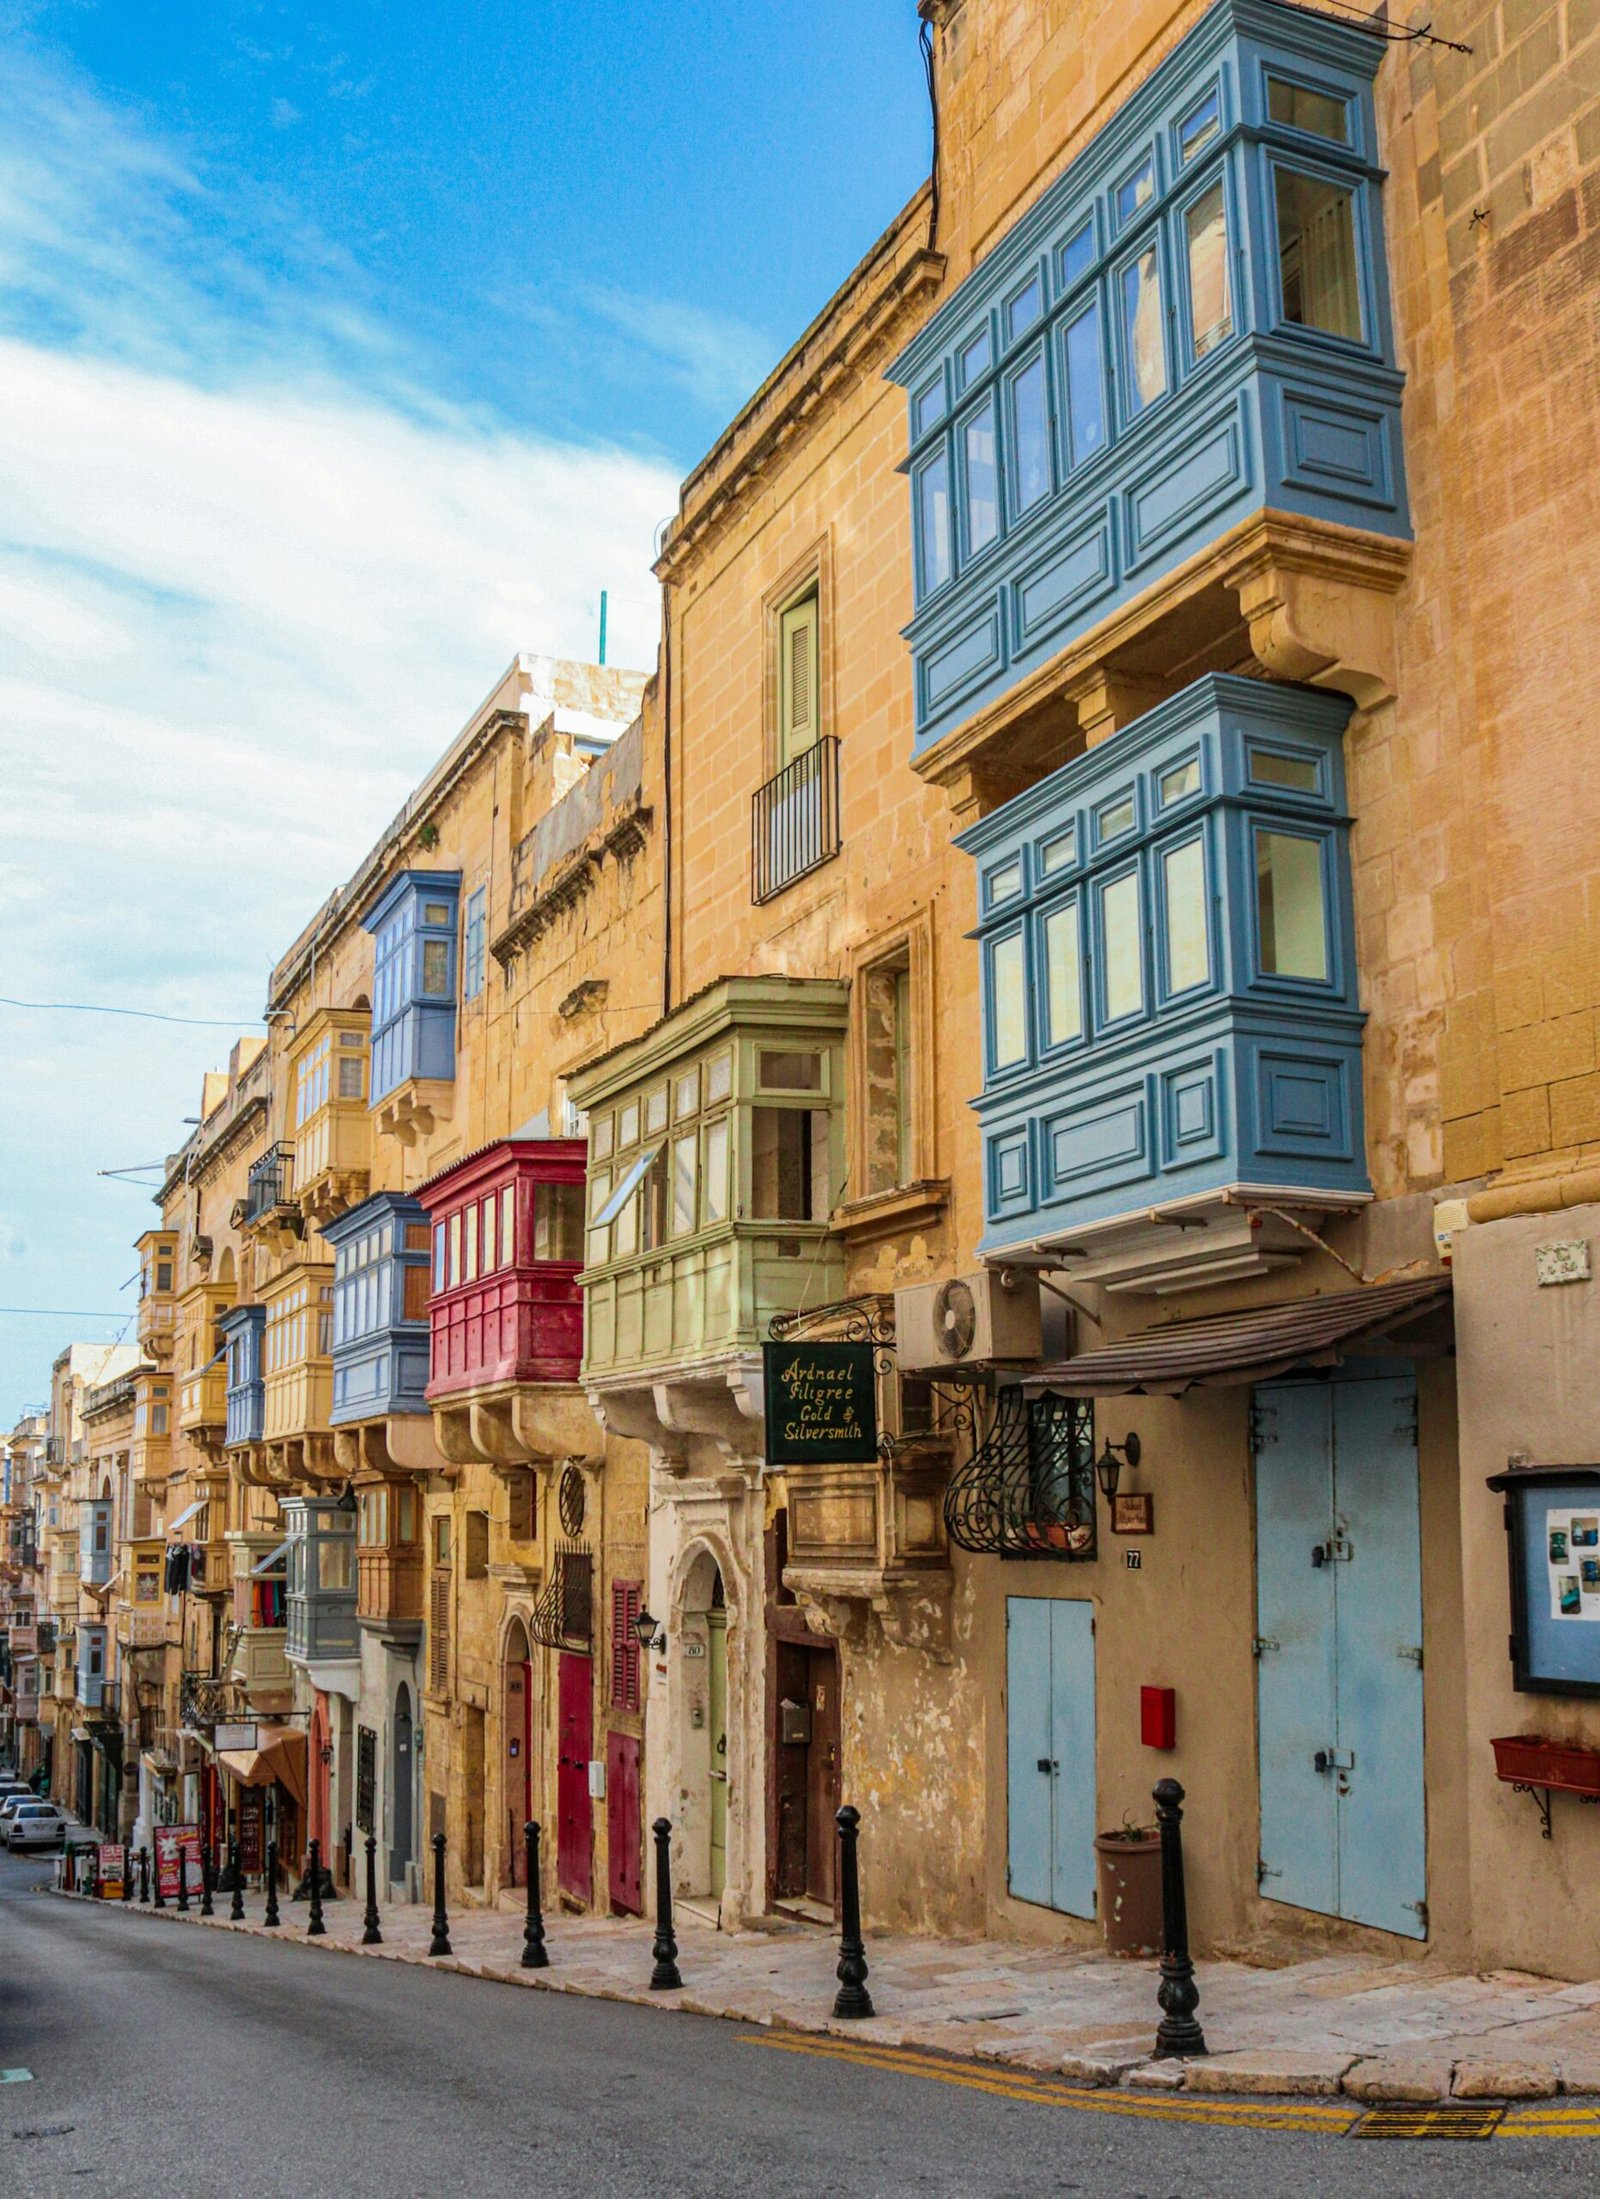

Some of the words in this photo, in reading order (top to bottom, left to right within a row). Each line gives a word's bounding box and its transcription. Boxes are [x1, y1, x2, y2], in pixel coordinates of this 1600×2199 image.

[781, 1357, 854, 1382] Ardnael
[789, 1381, 854, 1405] Filigree
[800, 1405, 832, 1421] Gold
[843, 1406, 854, 1423] &
[784, 1421, 862, 1440] Silversmith
[688, 1646, 701, 1655] 80
